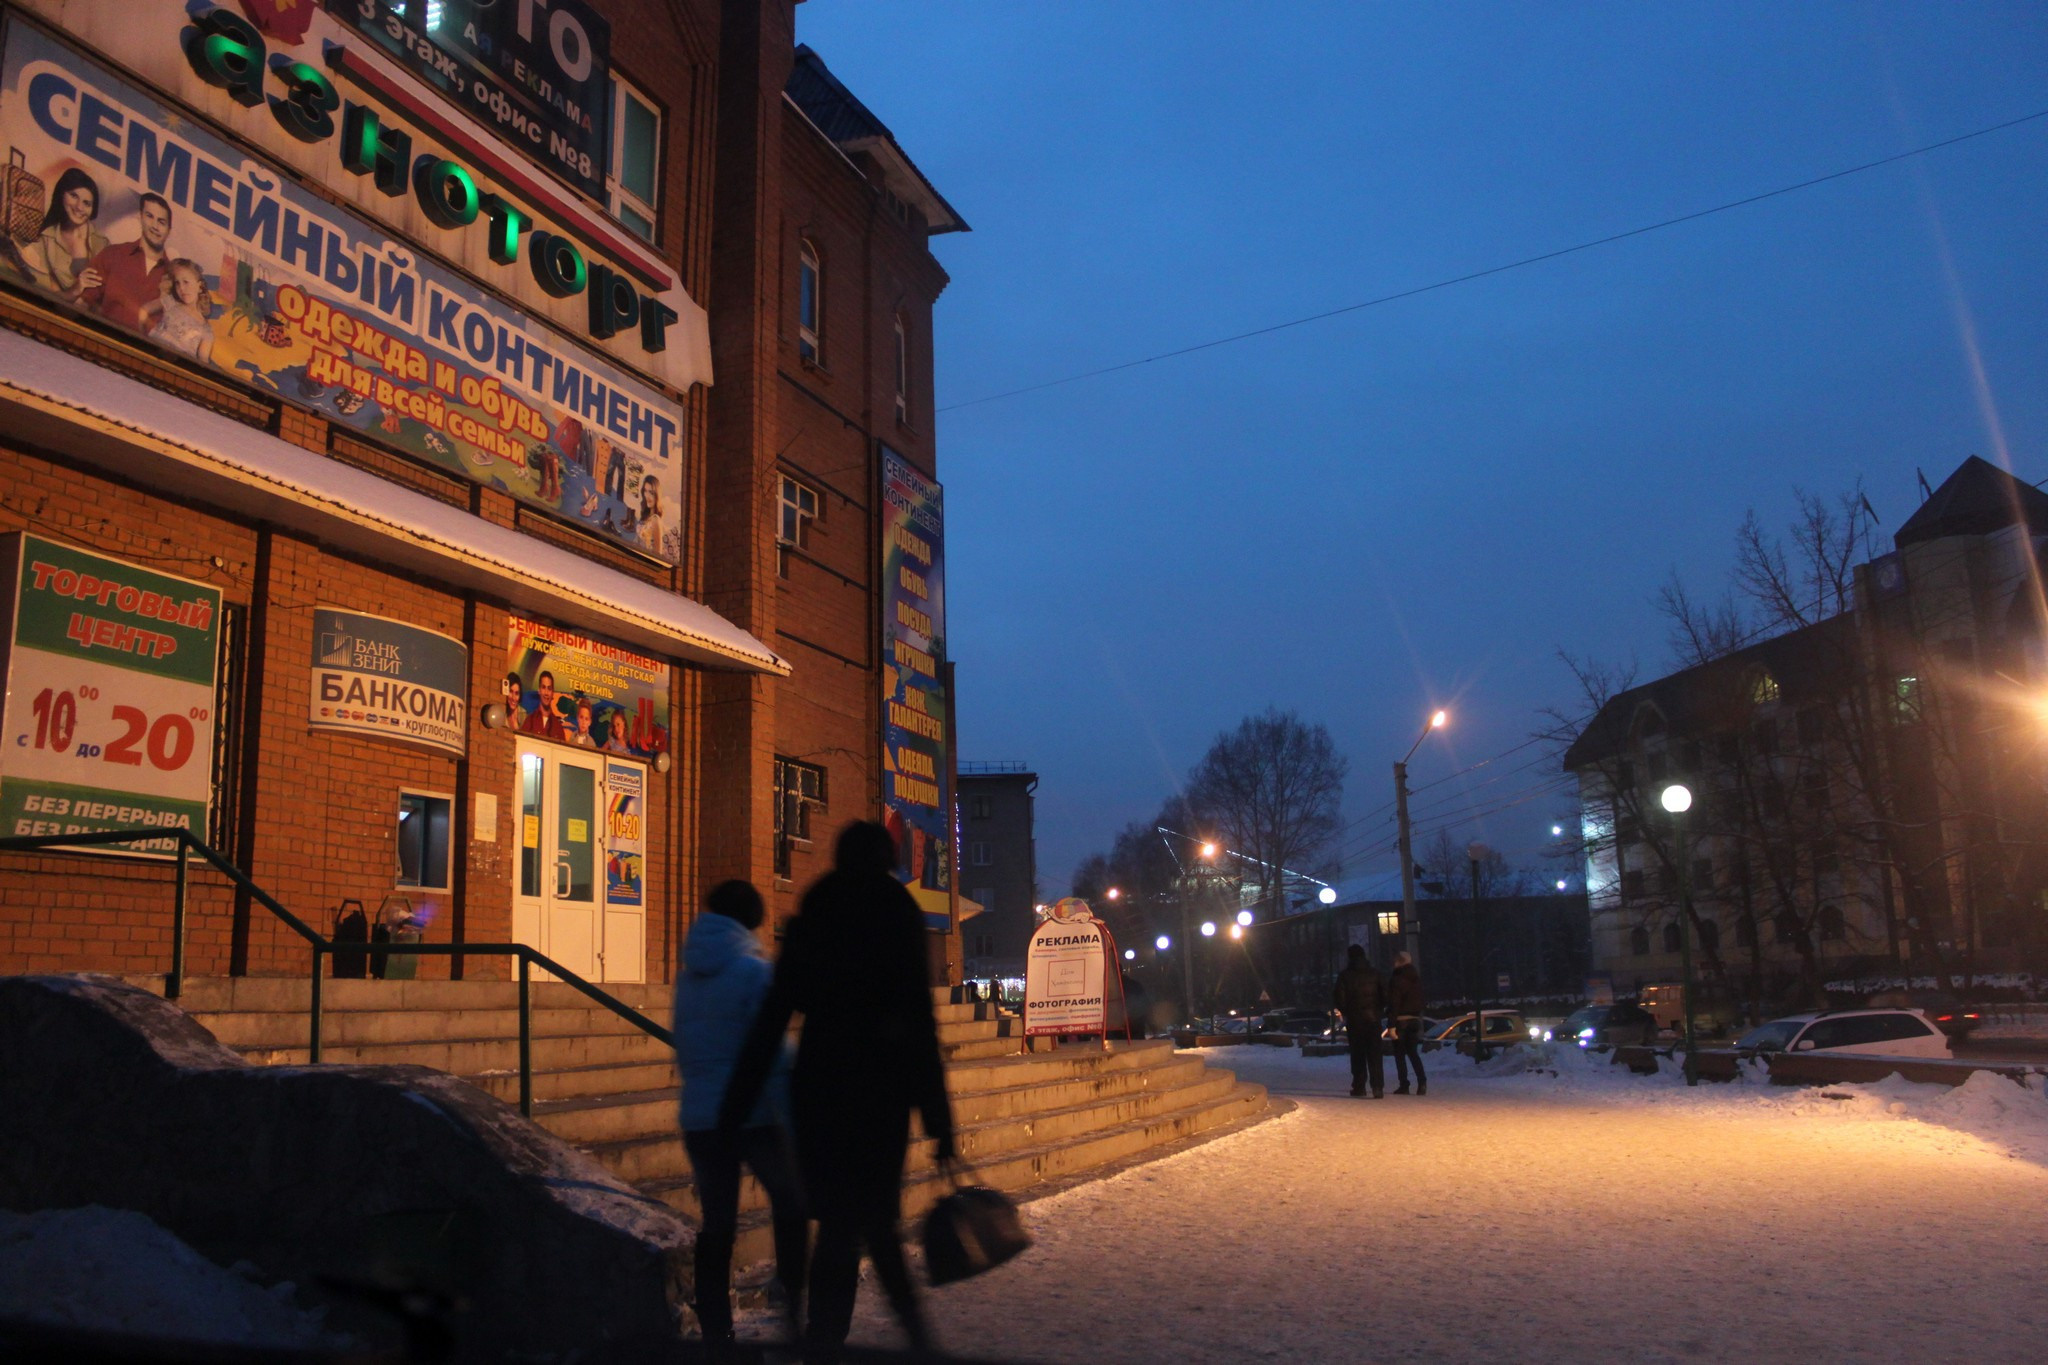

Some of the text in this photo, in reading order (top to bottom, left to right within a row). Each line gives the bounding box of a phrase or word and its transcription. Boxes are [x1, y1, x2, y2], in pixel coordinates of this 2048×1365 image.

[384, 15, 465, 92] этаж,
[473, 80, 542, 144] офис
[549, 129, 592, 179] №8
[500, 49, 593, 134] РЕКЛАМА
[27, 70, 676, 460] СЕМЕЙНЫЙ КОНТИНЕНТ
[277, 284, 549, 440] одежда и обувь
[309, 345, 527, 468] для всей семьи
[885, 456, 940, 508] СЕМЕЙНЫЙ
[884, 484, 941, 537] КОНТИНЕНТ
[894, 522, 932, 566] ОДЕЖДА
[31, 561, 213, 631] ТОРГОВЫЙ
[899, 565, 928, 601] ОБУВЬ
[66, 612, 177, 660] ЦЕНТР
[897, 600, 932, 640] ПОСУДА
[352, 653, 402, 675] ЗЕНИТ
[355, 638, 400, 660] БАНК
[521, 636, 656, 684] МУЖСКАЯ, ЖЕНСКАЯ, ДЕТСКАЯ
[591, 642, 665, 673] КОНТИНЕНТ
[894, 640, 935, 678] ИГРУШКИ
[553, 660, 629, 690] ОДЕЖДА И ОБУВЬ
[568, 679, 614, 699] ТЕКСТИЛЬ
[320, 673, 464, 729] БАНКОМАТ
[17, 734, 29, 748] с
[32, 687, 77, 753] 10
[76, 743, 101, 758] до
[103, 704, 195, 771] 20
[889, 700, 943, 742] ГАЛАНТЕРЕЯ
[609, 773, 640, 785] СЕМЕЙНЫЙ
[609, 784, 640, 796] КОНТИНЕНТ
[894, 773, 939, 807] ПОДУШКИ
[14, 819, 61, 837] БЕЗ
[24, 794, 191, 830] БЕЗ ПЕРЕРЫВА
[609, 811, 640, 841] 10-20
[1037, 935, 1100, 947] РЕКЛАМА
[1029, 998, 1101, 1009] ФОТОГРАФИЯ
[1062, 1023, 1085, 1033] офис
